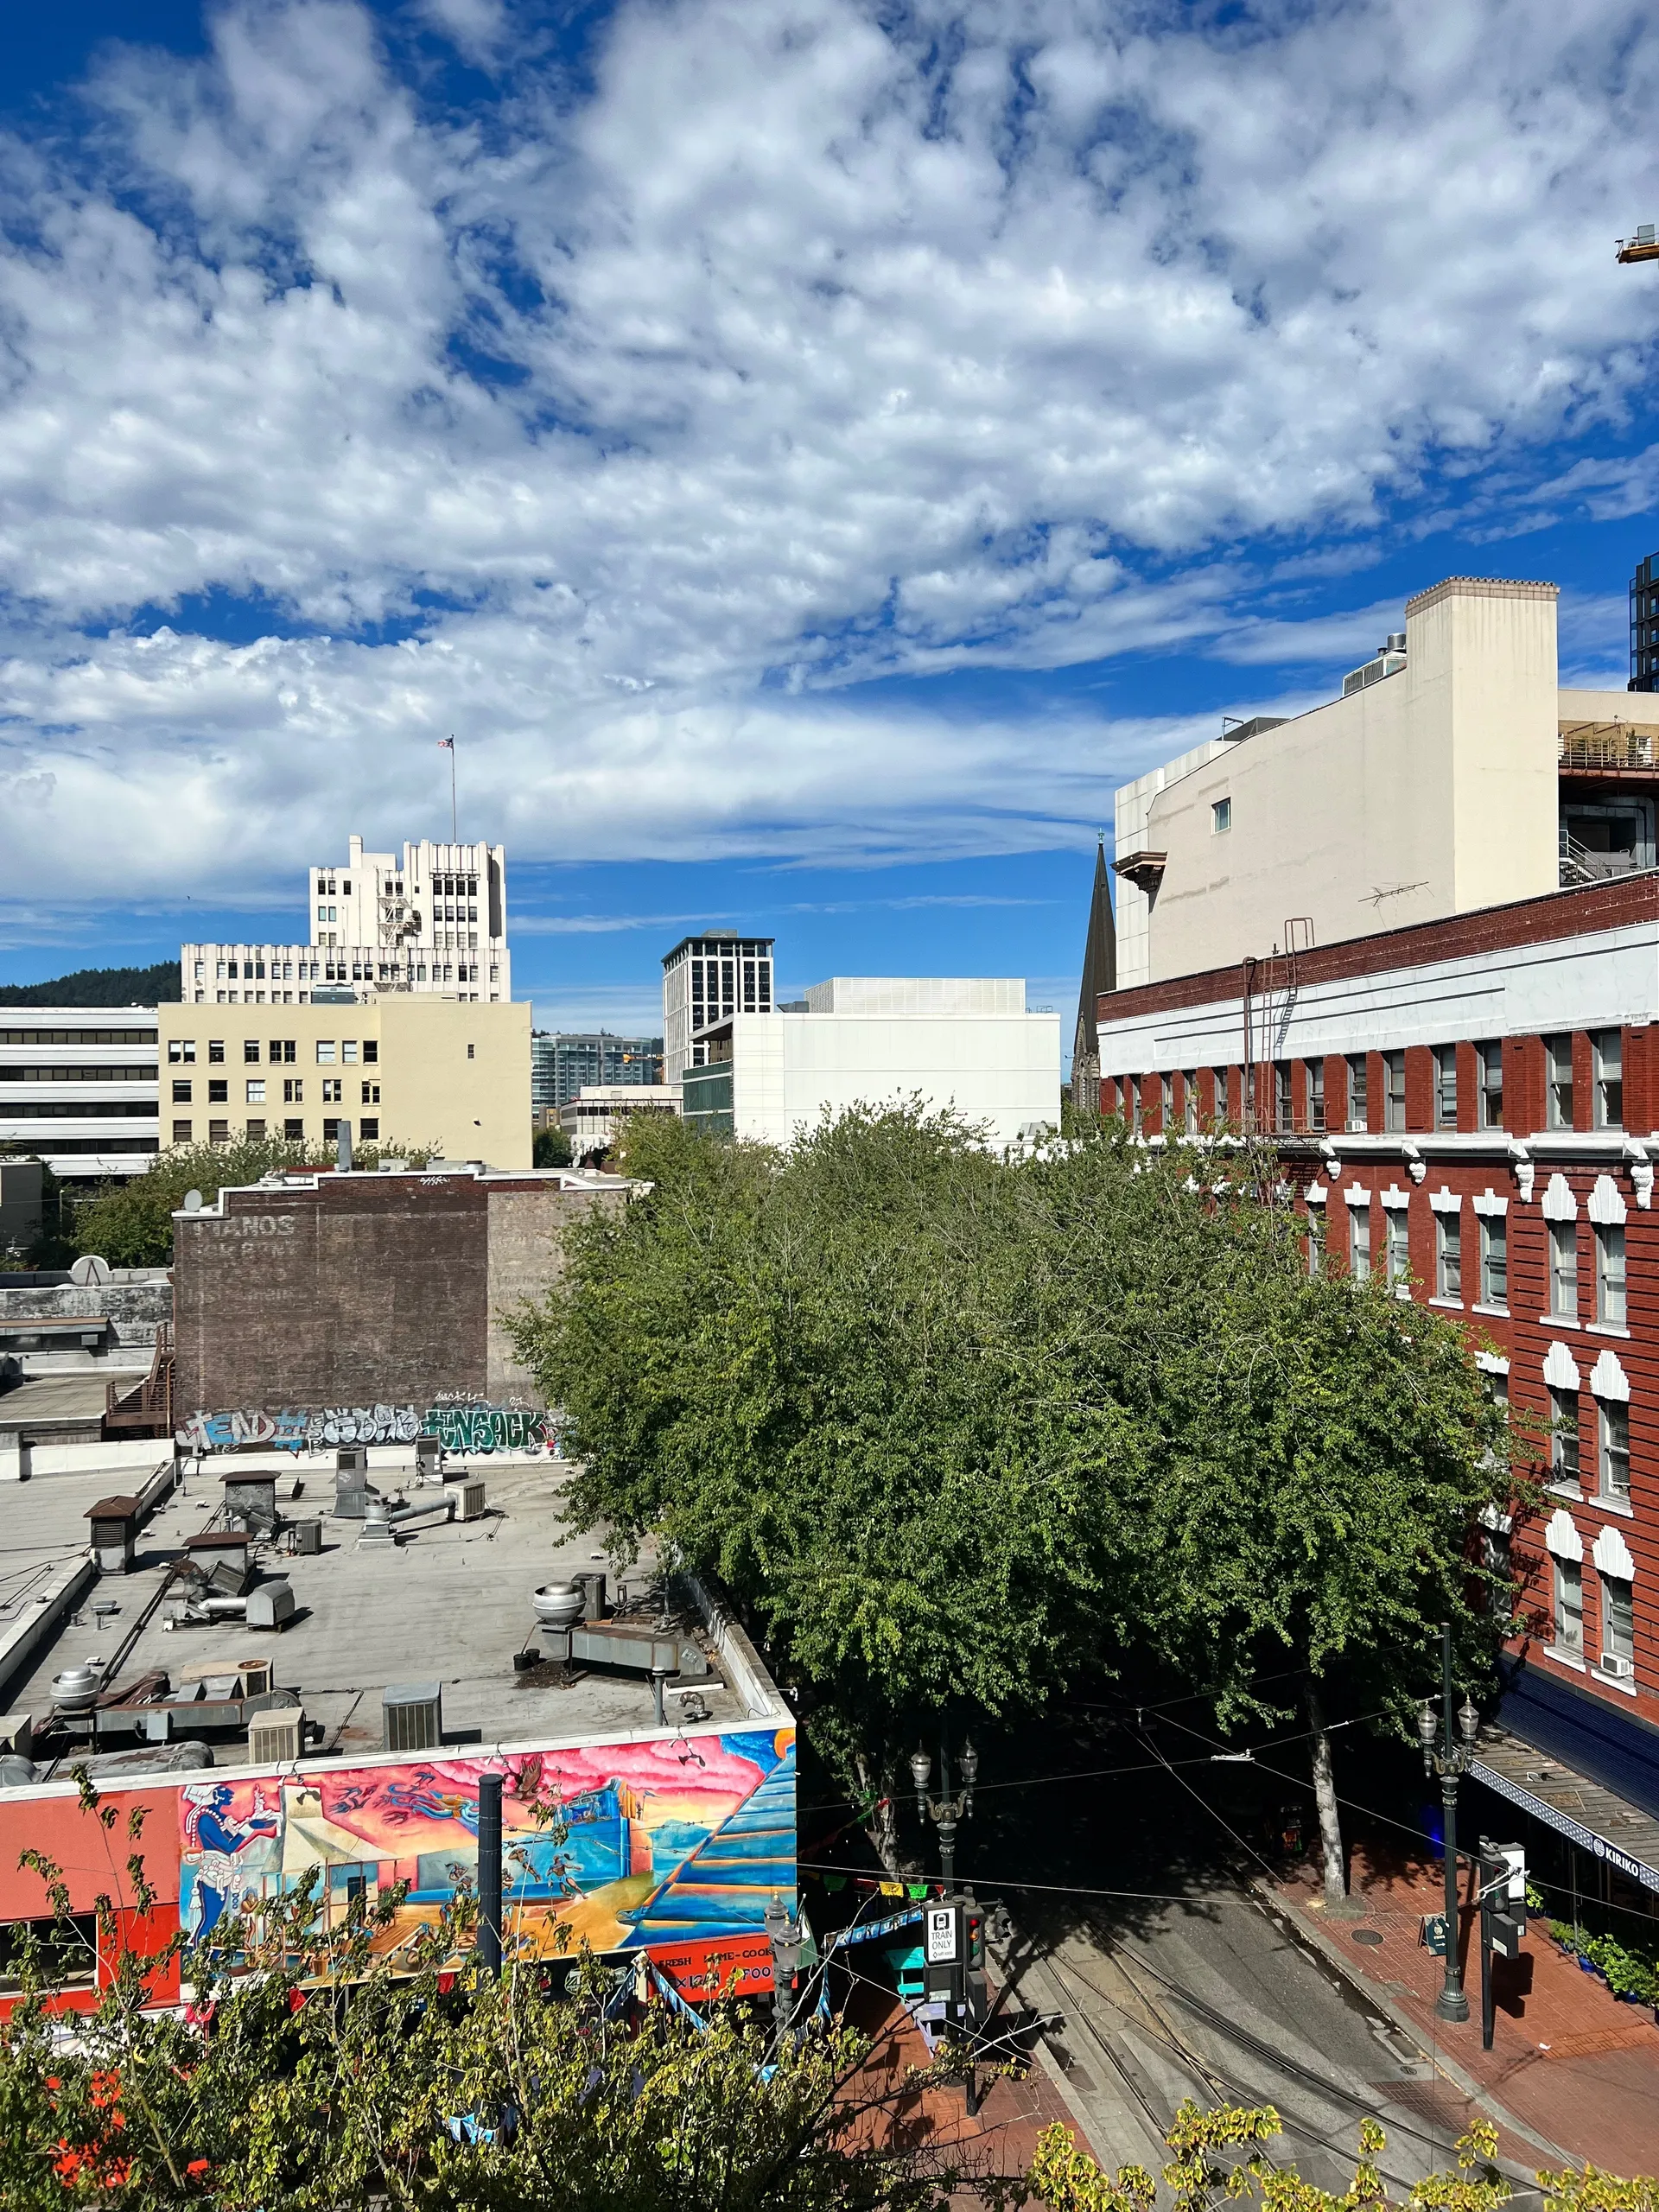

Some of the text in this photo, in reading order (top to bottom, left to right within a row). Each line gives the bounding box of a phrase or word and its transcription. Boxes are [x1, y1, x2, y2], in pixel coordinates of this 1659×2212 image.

[1605, 1847, 1639, 1877] KIRIKO
[931, 1929, 953, 1941] TRAIN
[931, 1940, 952, 1950] ONLY
[658, 1948, 773, 1968] FRESH HME-COOK
[742, 1966, 772, 1981] FOO
